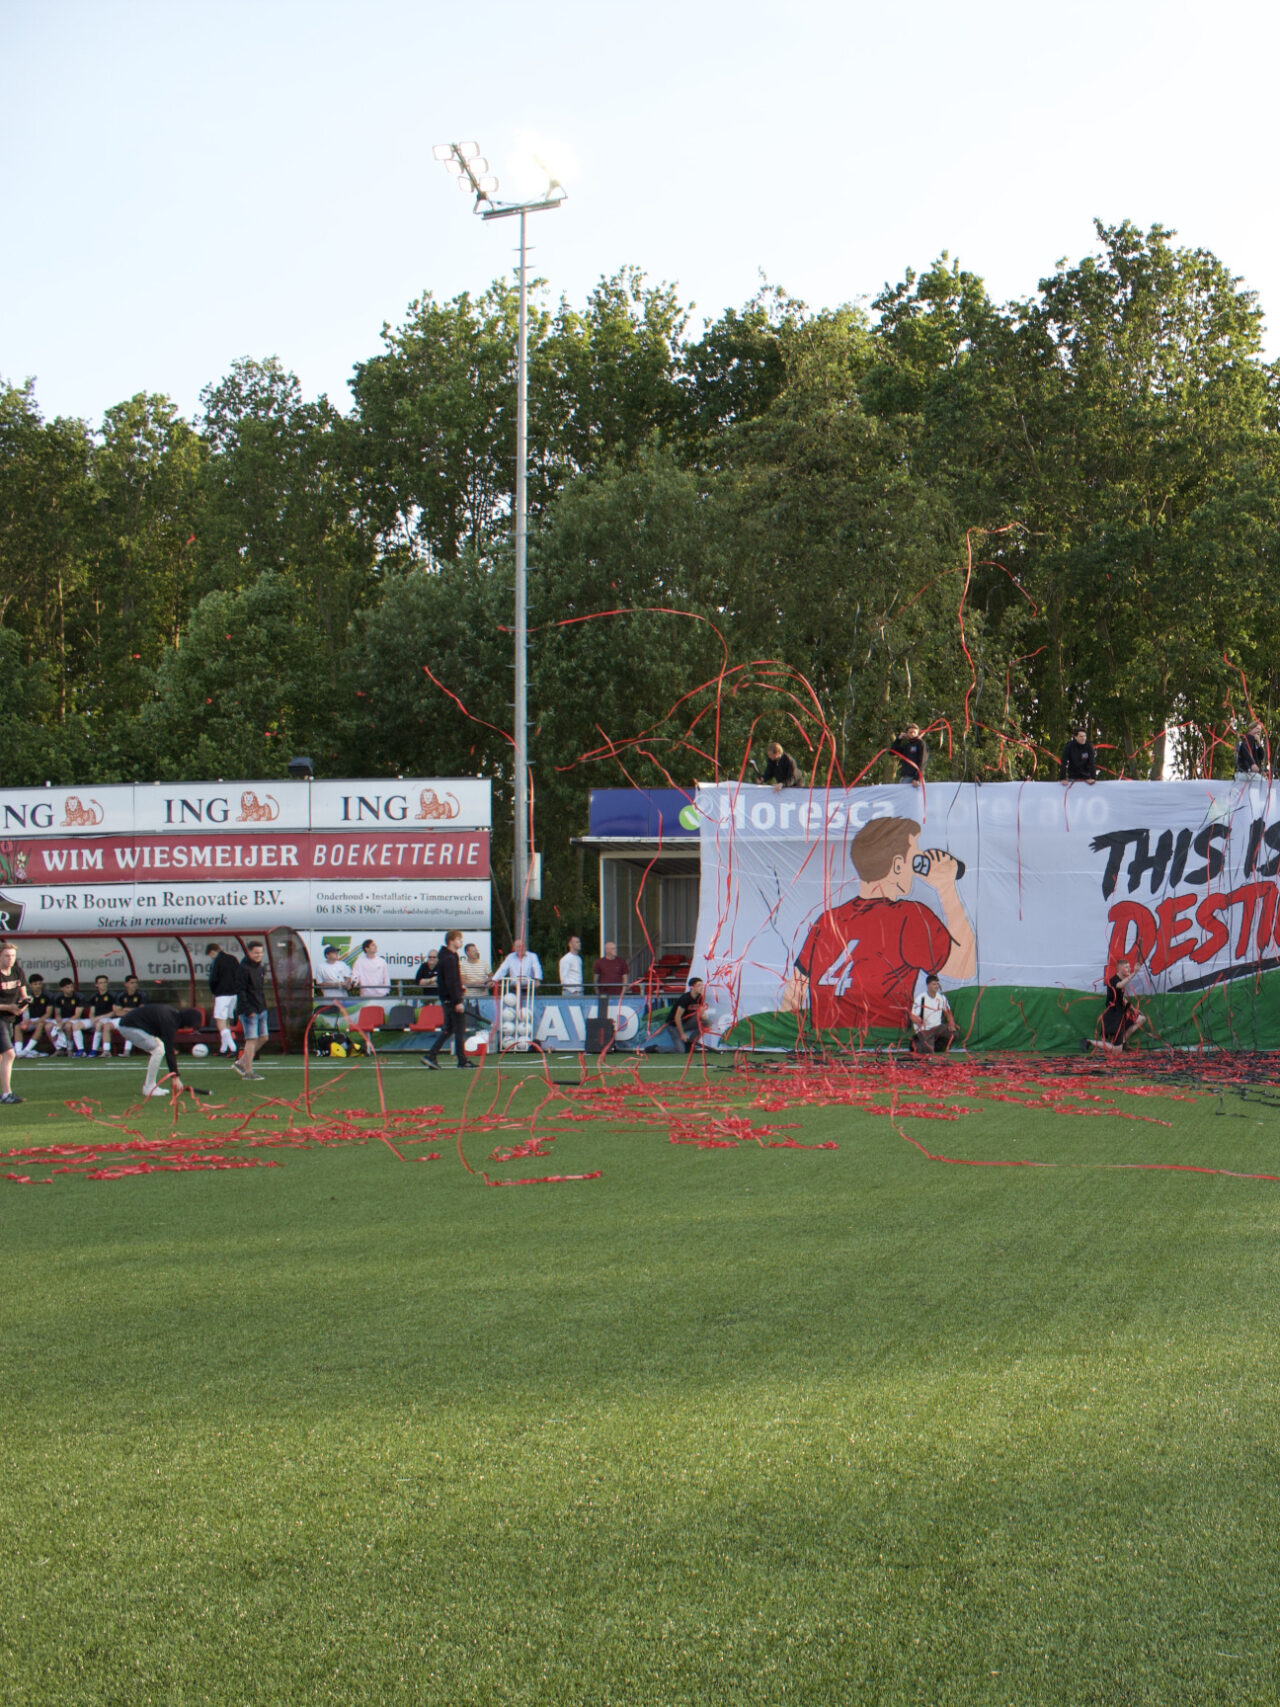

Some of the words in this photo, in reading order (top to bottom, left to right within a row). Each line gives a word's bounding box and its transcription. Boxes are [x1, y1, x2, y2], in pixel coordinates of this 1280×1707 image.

[164, 798, 230, 824] ING
[341, 795, 409, 821] ING
[42, 848, 104, 871] WIM
[114, 845, 299, 869] WIESMEIJER
[312, 842, 481, 866] BOEKETTERIE
[1089, 823, 1232, 900] THIS
[40, 893, 78, 910] DvR
[83, 892, 132, 909] Bouw
[137, 896, 157, 907] en
[163, 890, 248, 907] Renovatie
[253, 890, 284, 906] B.V.
[316, 892, 364, 901] Onderhoud
[421, 892, 483, 901] Timmerwerken
[316, 904, 329, 914] 06
[98, 916, 129, 928] Sterk
[131, 916, 142, 927] in
[145, 914, 228, 927] renovatiewerk
[818, 939, 859, 996] 4
